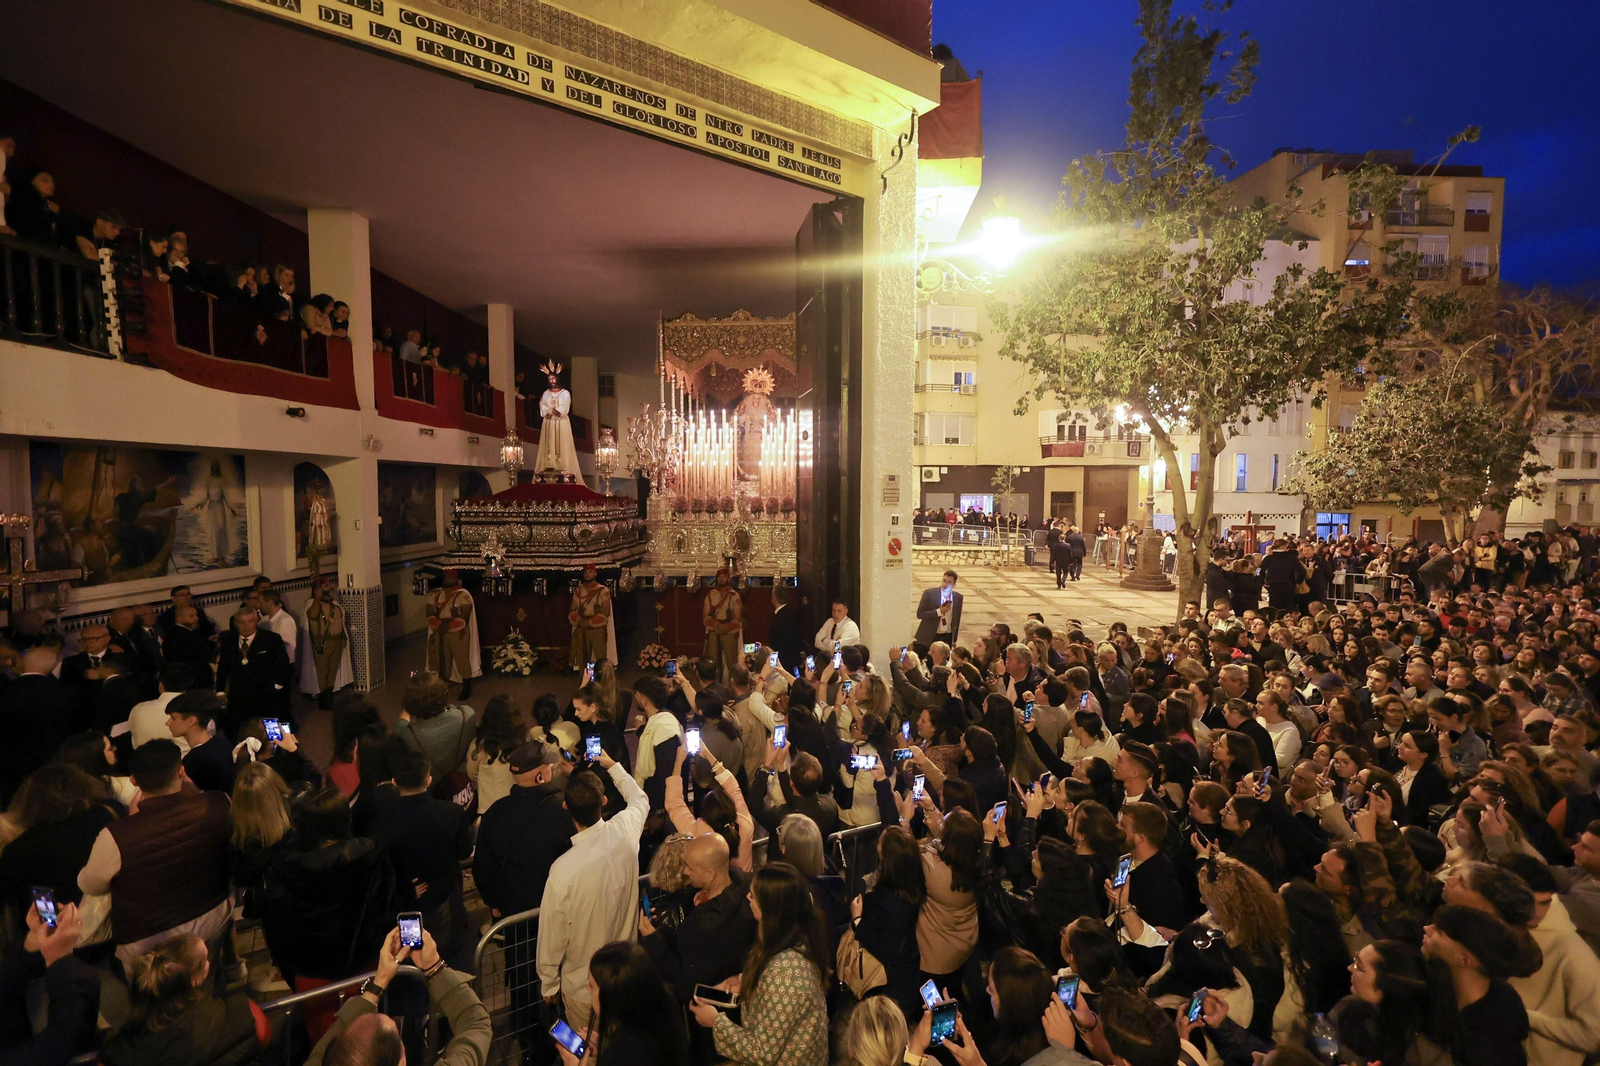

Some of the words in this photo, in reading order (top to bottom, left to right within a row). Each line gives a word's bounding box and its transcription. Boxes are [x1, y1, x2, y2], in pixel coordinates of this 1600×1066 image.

[321, 7, 351, 27] DE
[372, 23, 400, 43] LA
[418, 38, 528, 83] TRINIDAD
[543, 78, 553, 91] Y
[568, 87, 600, 107] DEL
[613, 102, 697, 138] GLORIOSO
[706, 133, 769, 161] APOSTOL
[779, 156, 841, 184] SANTIAGO
[343, 0, 382, 14] LE
[401, 10, 513, 58] COFRADIA
[528, 53, 551, 71] DE
[565, 66, 665, 109] NAZARENOS
[677, 104, 695, 120] DE
[706, 115, 743, 136] NTRO
[753, 130, 793, 152] PADRE
[804, 148, 840, 168] JESUS
